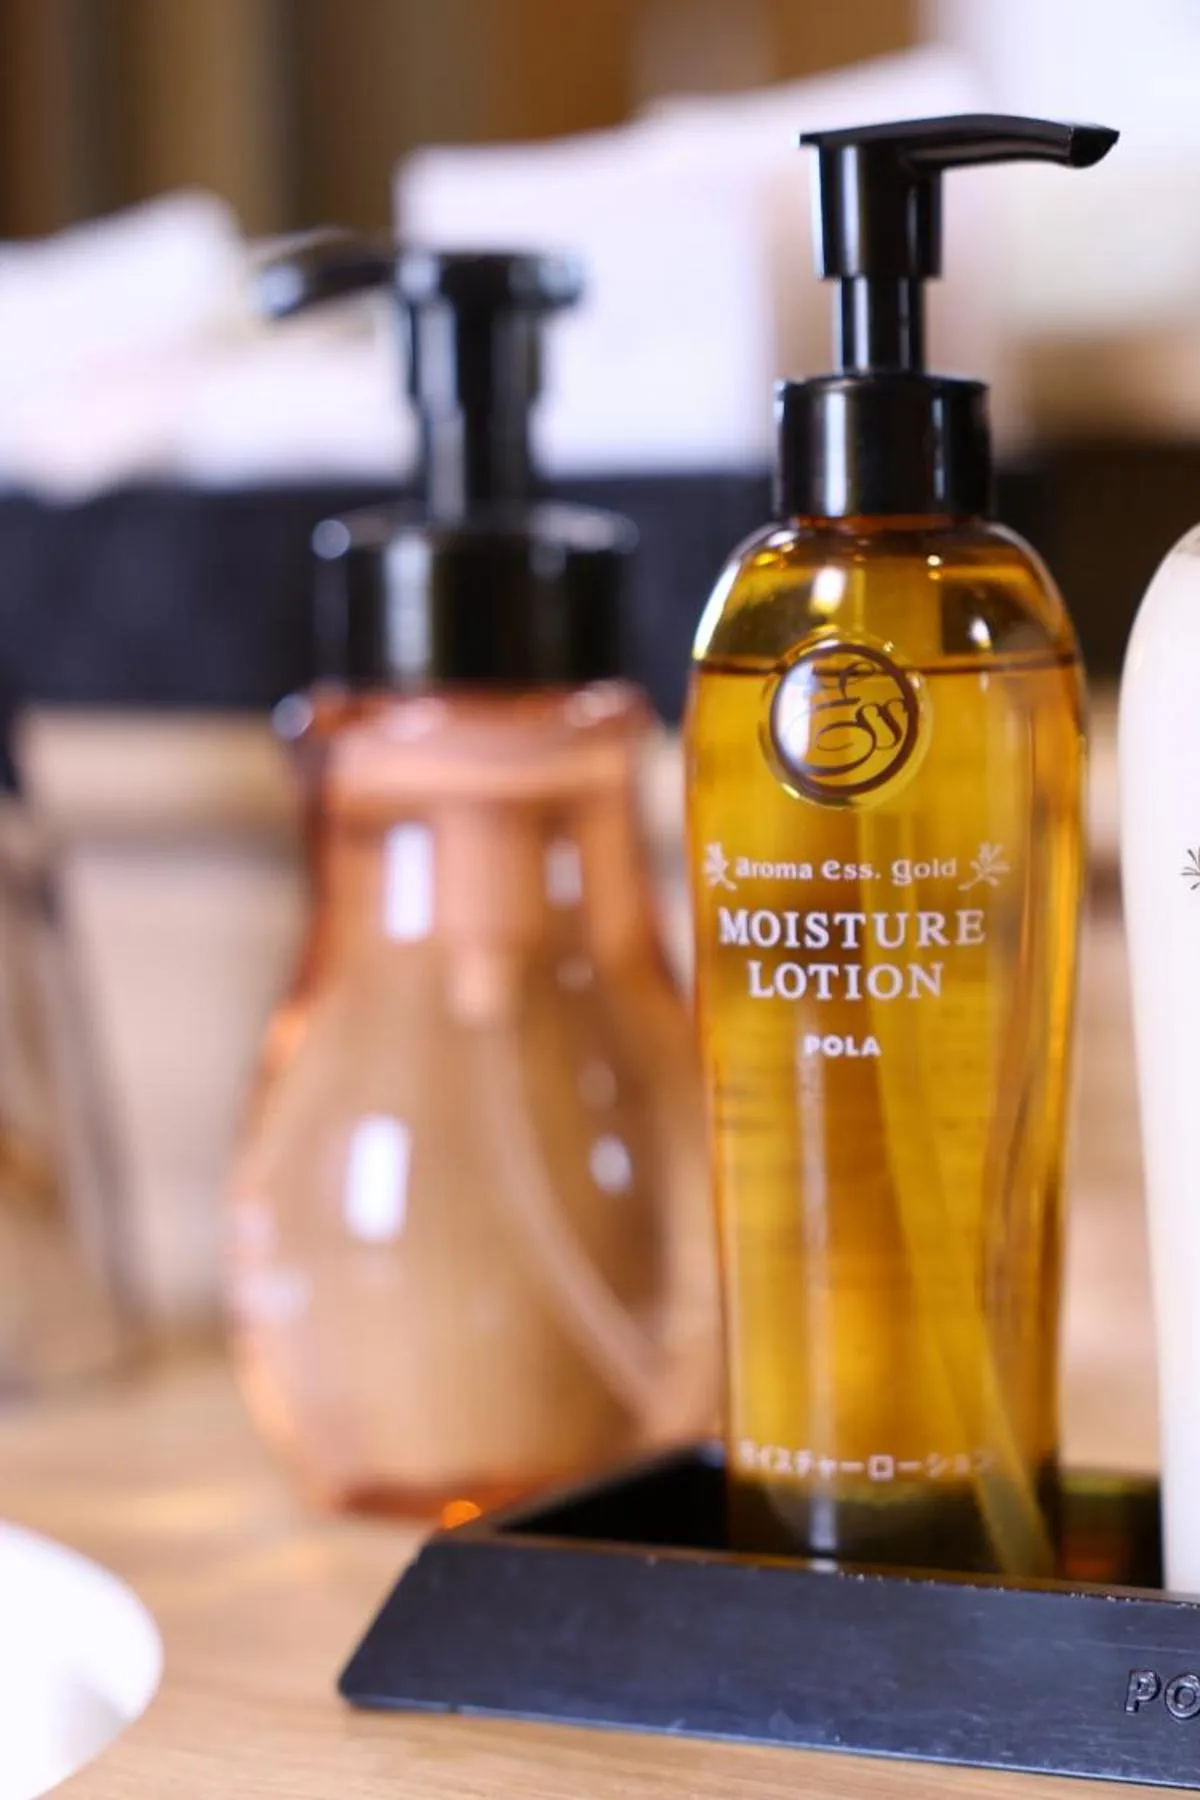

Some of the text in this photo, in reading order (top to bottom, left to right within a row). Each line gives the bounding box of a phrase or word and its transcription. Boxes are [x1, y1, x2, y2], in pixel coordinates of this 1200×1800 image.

[735, 857, 958, 884] aroma ess. gold
[718, 907, 986, 950] MOISTURE
[747, 960, 944, 1001] LOTION
[803, 1035, 881, 1057] POLA
